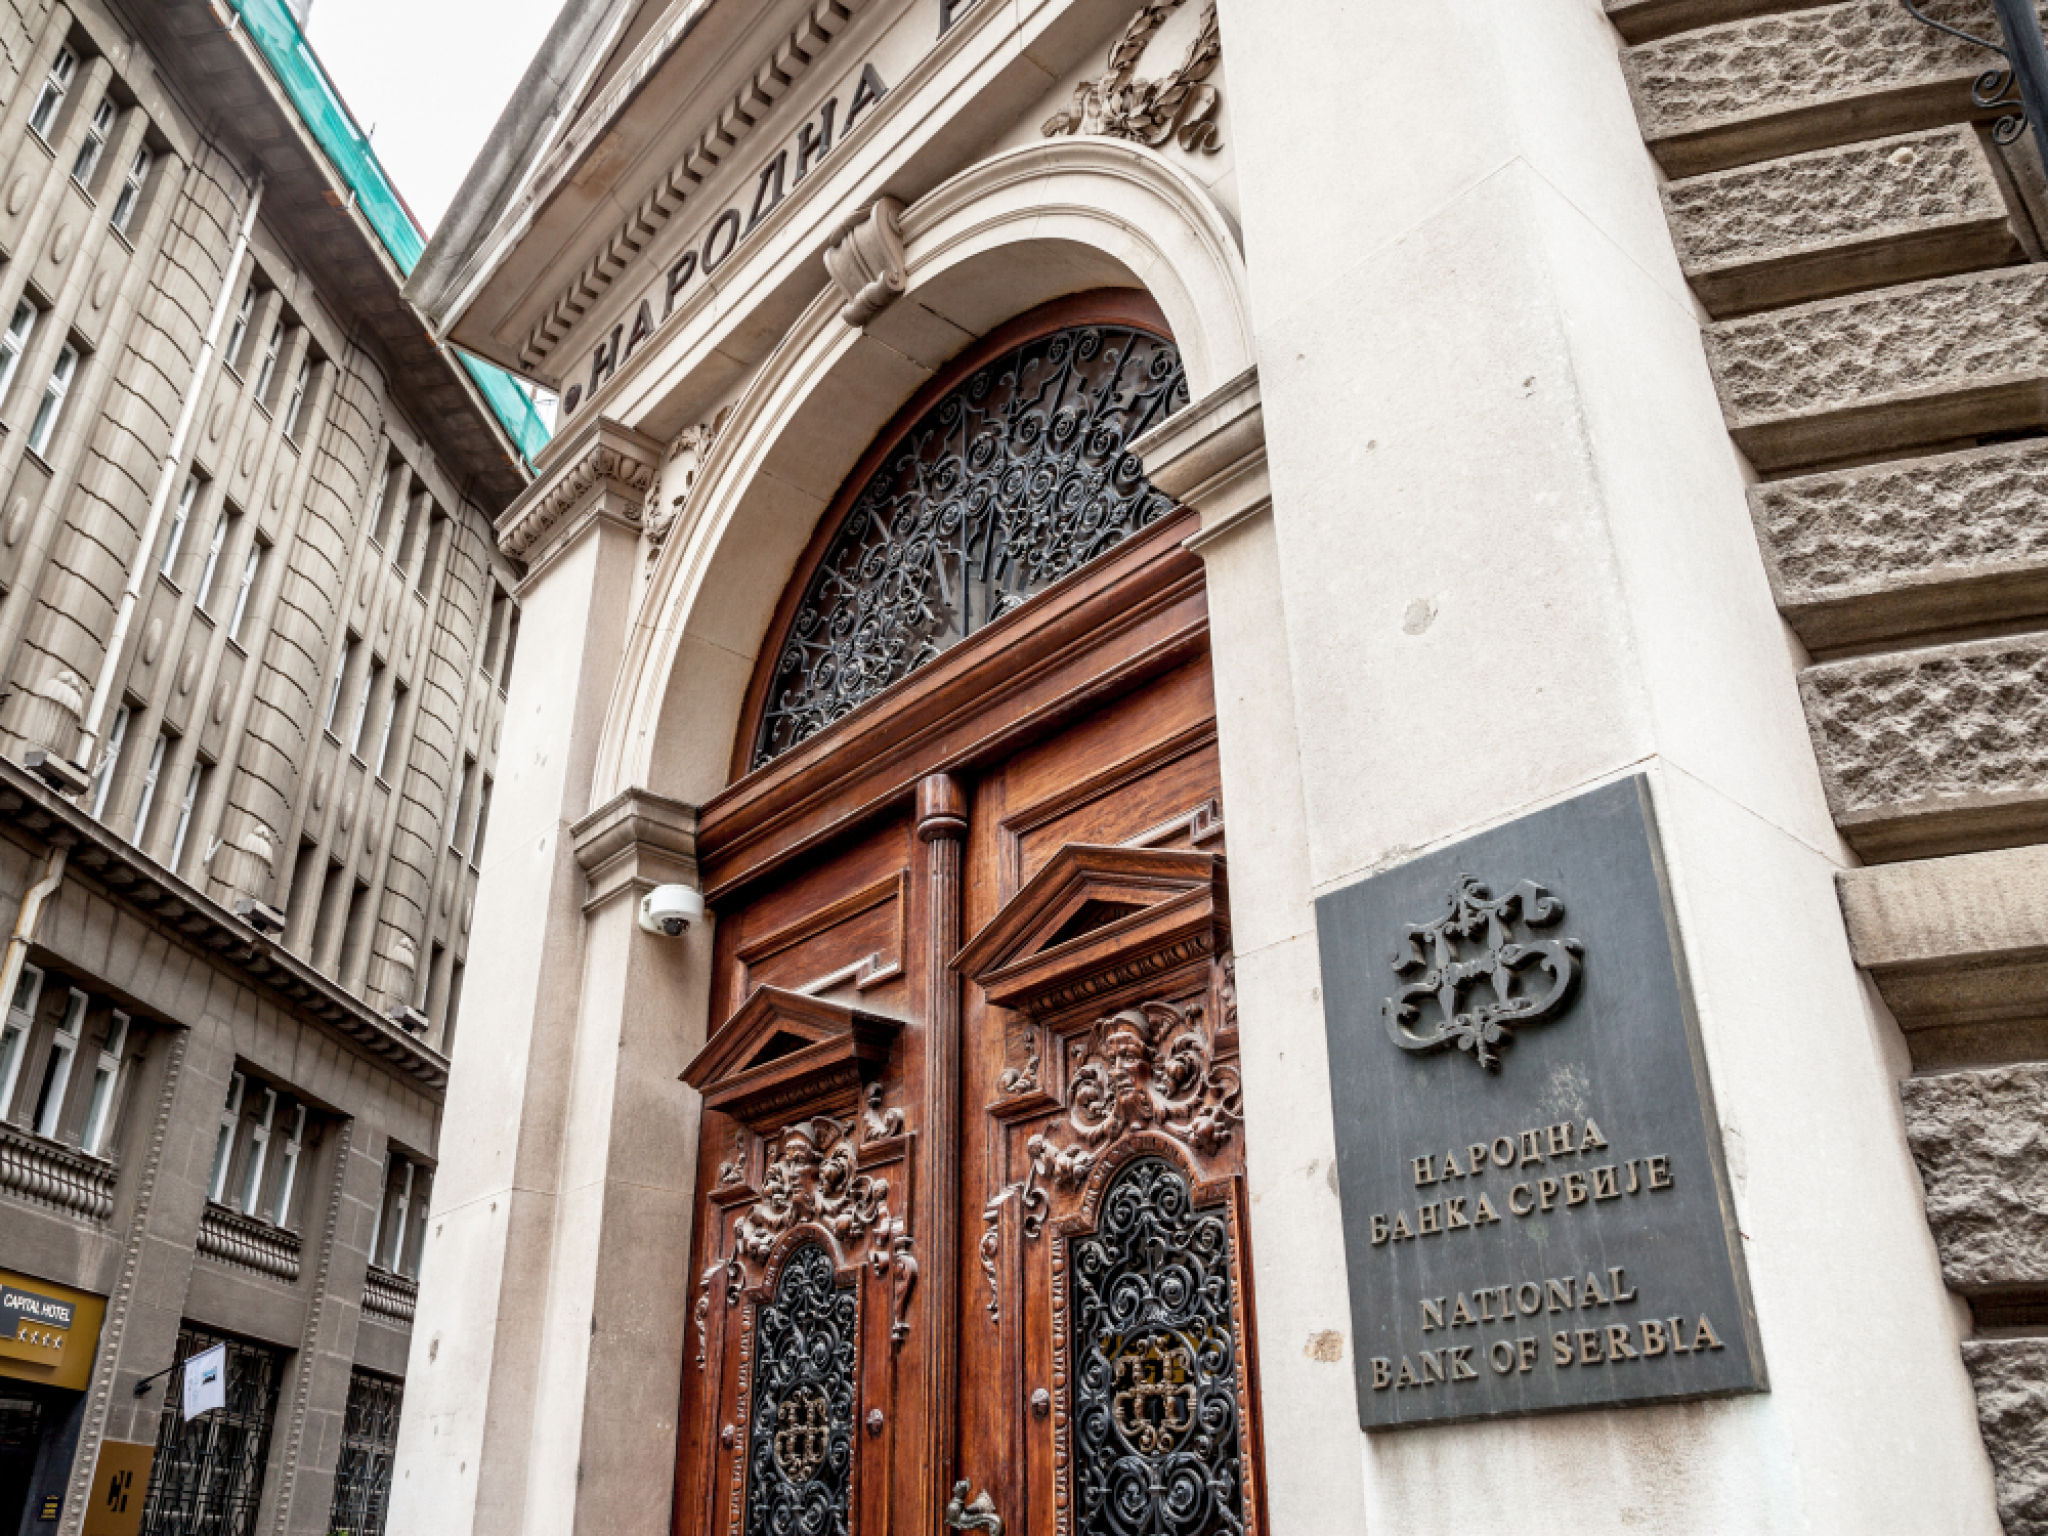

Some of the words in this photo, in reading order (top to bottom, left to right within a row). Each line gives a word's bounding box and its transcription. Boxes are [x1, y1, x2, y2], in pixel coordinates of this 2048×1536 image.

[586, 63, 889, 402] НАРОДНА
[1411, 1118, 1609, 1188] НАРОДНА
[1370, 1191, 1501, 1245] БАНКА
[1508, 1153, 1675, 1216] СРБИЈЕ
[3, 1292, 40, 1315] CAPITAL
[41, 1302, 71, 1322] HOTEL
[1420, 1265, 1638, 1331] NATIONAL
[1370, 1345, 1479, 1390] BANK
[1490, 1335, 1539, 1374] OF
[1552, 1312, 1725, 1367] SERBIA
